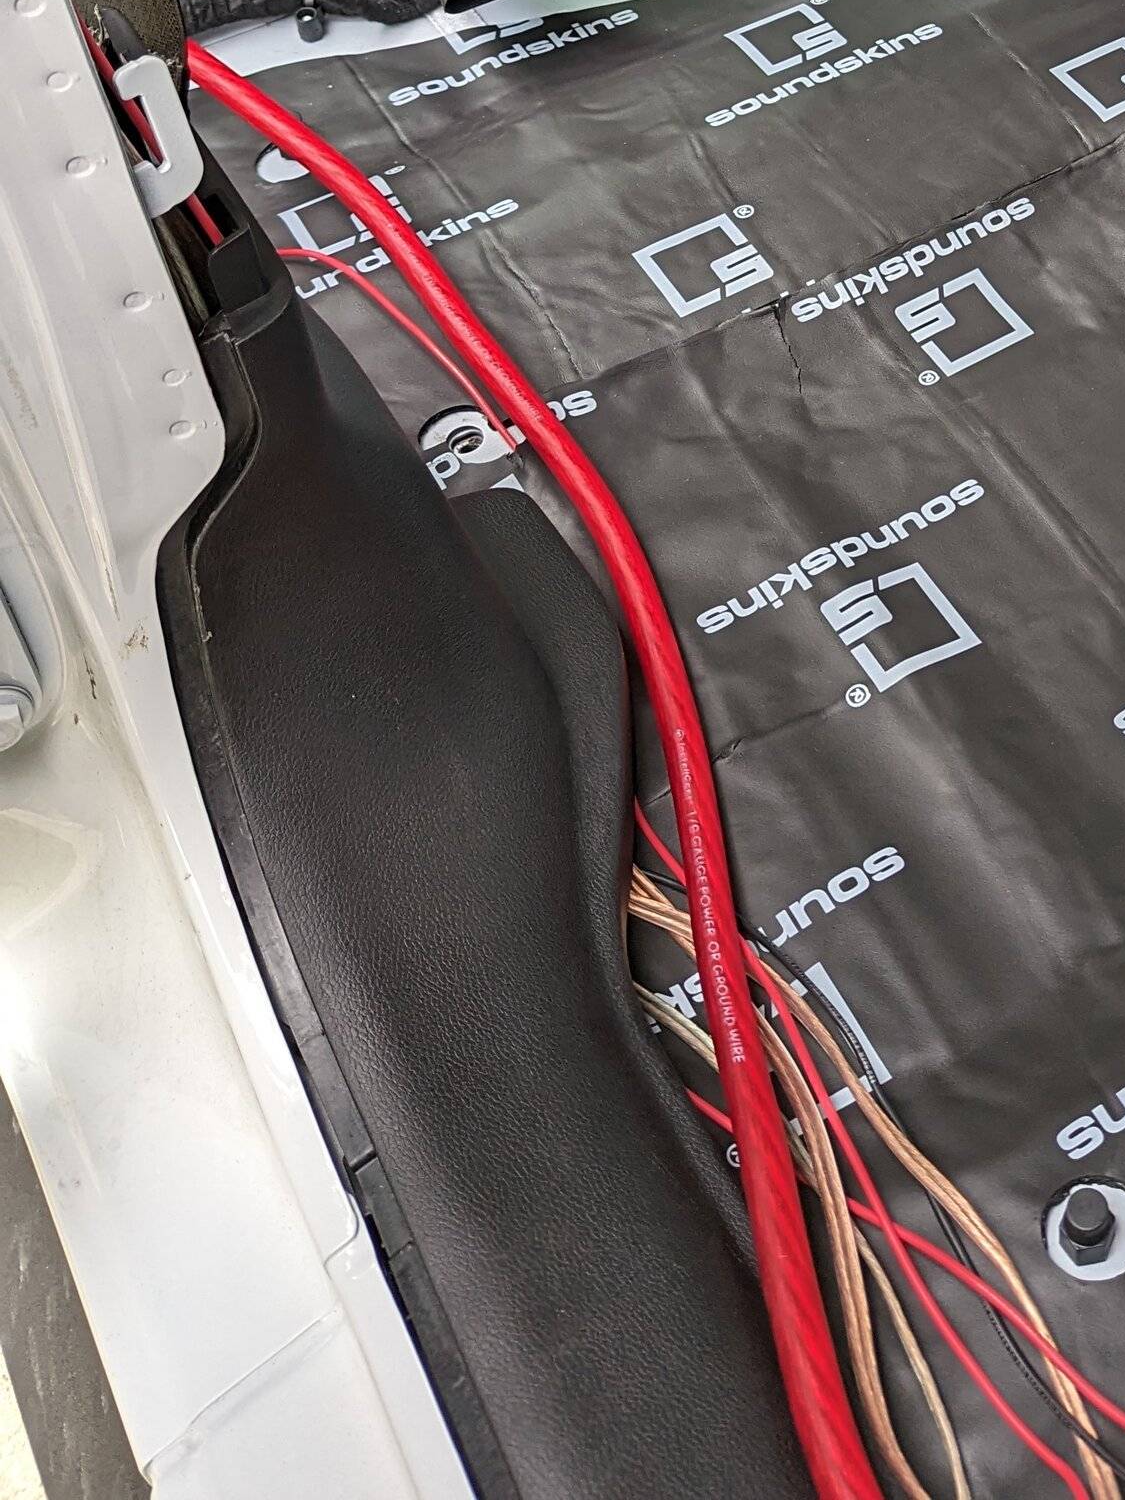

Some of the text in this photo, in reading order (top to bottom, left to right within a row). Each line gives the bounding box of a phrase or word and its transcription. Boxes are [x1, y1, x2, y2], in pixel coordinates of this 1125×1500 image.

[387, 8, 640, 108] soundskins
[704, 22, 943, 128] soundskins
[791, 197, 1036, 323] soundskins
[696, 478, 985, 635] soundskins
[691, 832, 708, 885] GAUGE
[699, 885, 716, 938] POWER
[706, 940, 721, 963] OR
[710, 963, 736, 1028] GROUND
[726, 1027, 746, 1064] WIRE
